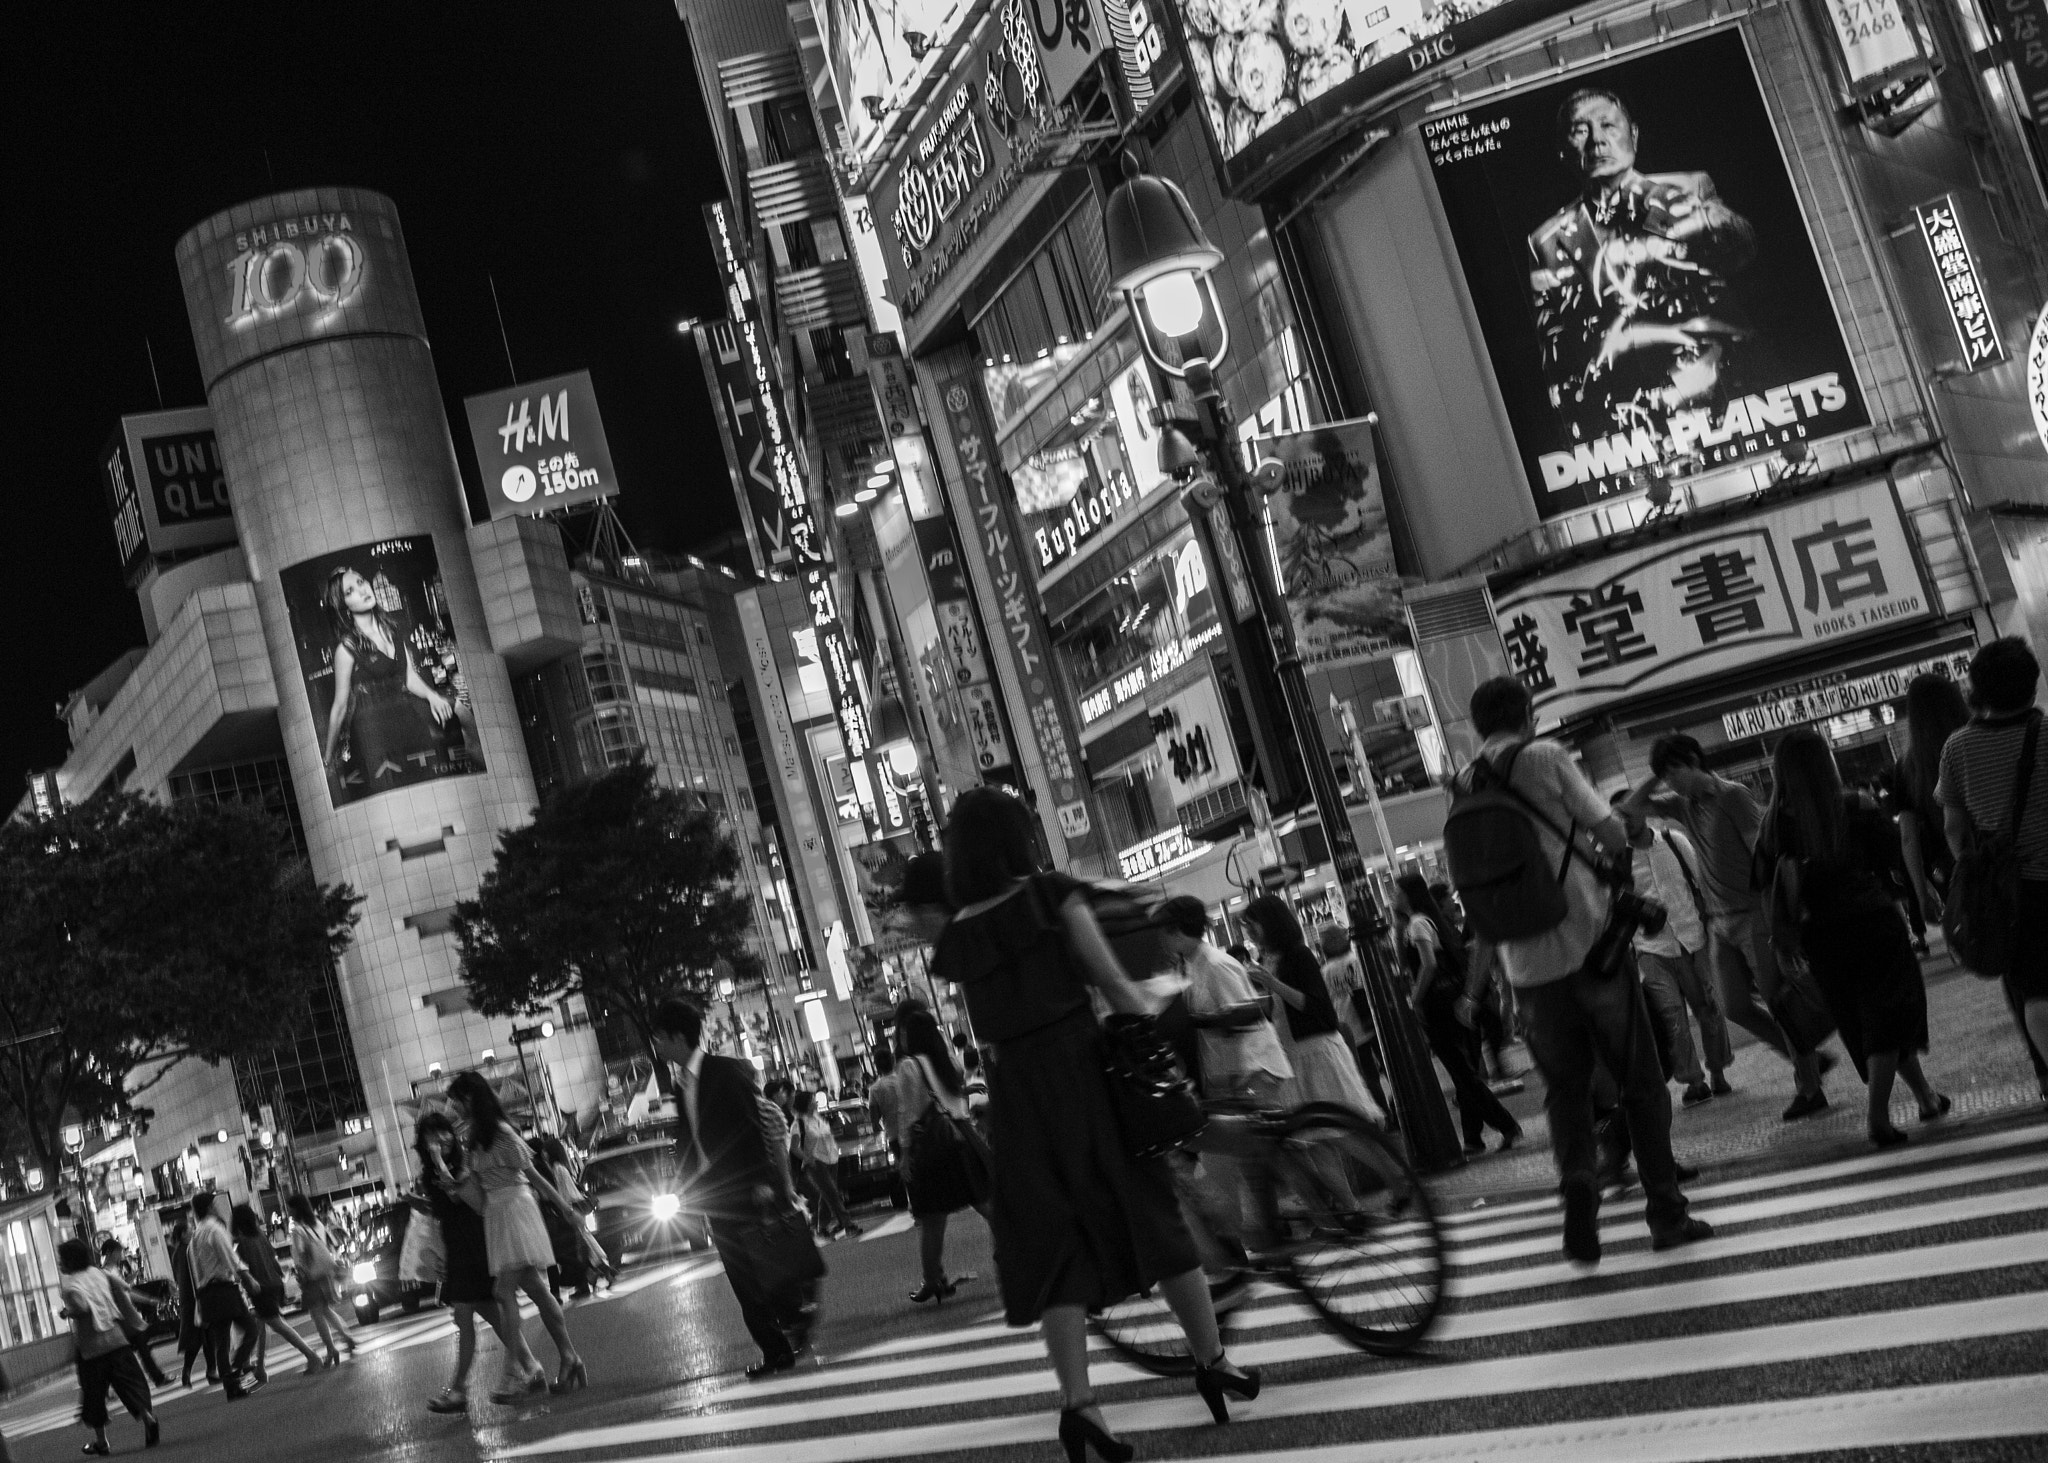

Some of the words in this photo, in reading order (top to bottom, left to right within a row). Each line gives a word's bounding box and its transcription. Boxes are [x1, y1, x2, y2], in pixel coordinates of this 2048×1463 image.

[1845, 13, 1896, 47] 2468
[1408, 33, 1456, 72] DHC
[1424, 113, 1470, 138] DMMは
[235, 212, 352, 251] SHIBUYA
[224, 233, 364, 323] 109
[1925, 208, 1995, 363] 大盛堂商事ビル
[498, 388, 570, 455] H&M
[1538, 424, 1659, 493] DMM
[1666, 371, 1847, 454] PLANETS
[155, 440, 222, 477] UNI
[537, 451, 580, 476] この先
[1698, 423, 1807, 466] teamLab
[540, 467, 600, 497] 150m
[1034, 470, 1133, 567] Euphoria
[929, 550, 954, 571] JTB
[1175, 539, 1207, 616] JTB
[1812, 613, 1857, 638] BOOKS
[1861, 596, 1920, 627] TAISEIDO
